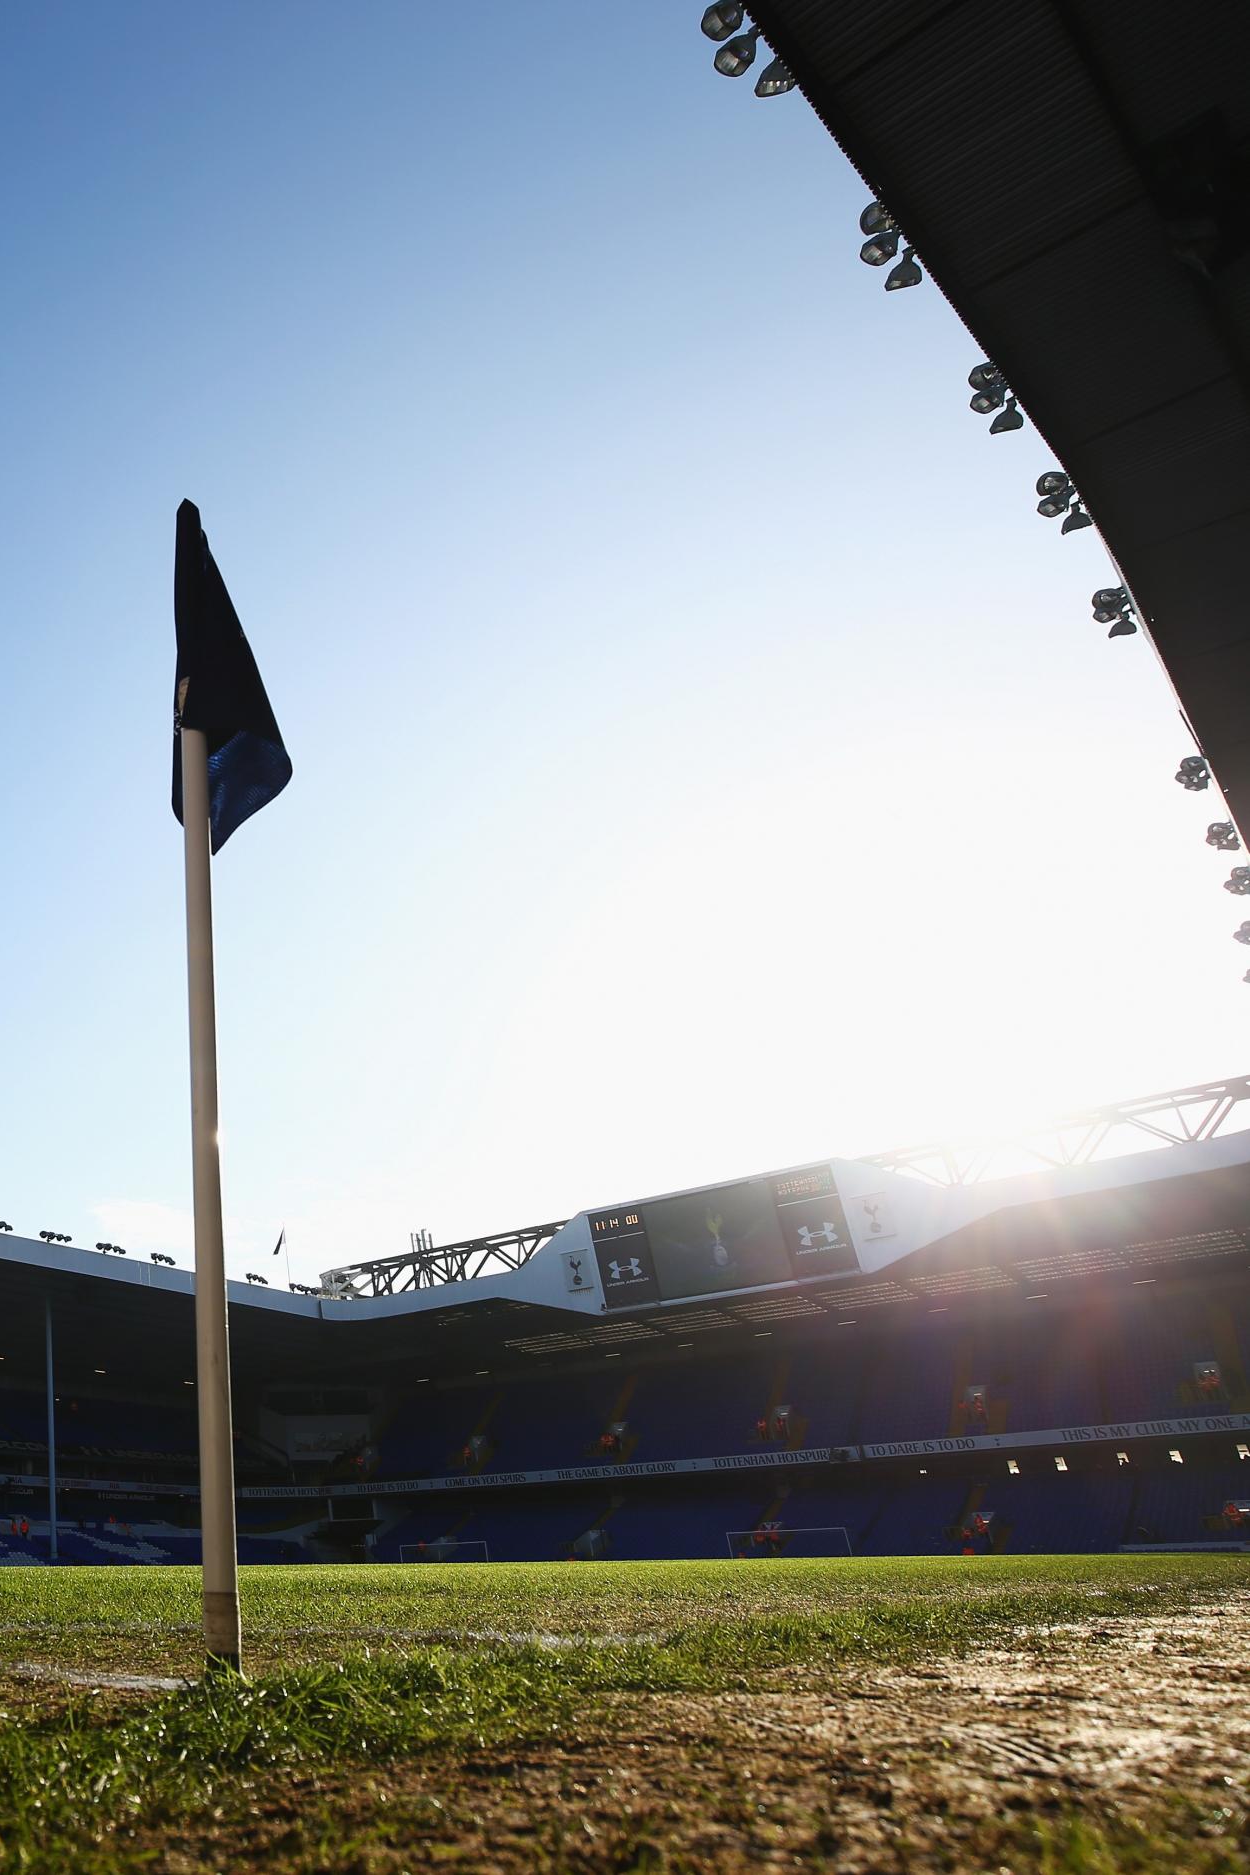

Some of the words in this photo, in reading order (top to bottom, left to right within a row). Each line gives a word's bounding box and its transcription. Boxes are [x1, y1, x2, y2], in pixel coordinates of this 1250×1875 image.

[1059, 1429, 1091, 1442] THIS
[1095, 1428, 1107, 1439] IS
[1107, 1426, 1132, 1439] MY
[1177, 1418, 1200, 1432] MY
[1205, 1416, 1239, 1430] ONE
[870, 1445, 886, 1457] TO
[889, 1443, 922, 1456] DARE
[924, 1442, 934, 1452] IS
[936, 1440, 954, 1451] TO
[957, 1438, 975, 1450] DO
[712, 1455, 775, 1468] TOTTENHAM
[778, 1450, 830, 1464] HOTSPUR
[445, 1477, 468, 1487] COME
[469, 1476, 480, 1486] ON
[481, 1475, 499, 1485] YOU
[499, 1473, 526, 1484] SPURS
[557, 1470, 574, 1480] THE
[575, 1467, 601, 1479] GAME
[602, 1467, 611, 1477] IS
[612, 1465, 644, 1477] ABOUT
[646, 1462, 678, 1474] GLORY
[387, 1483, 395, 1492] IS
[395, 1482, 406, 1492] TO
[407, 1481, 418, 1491] DO
